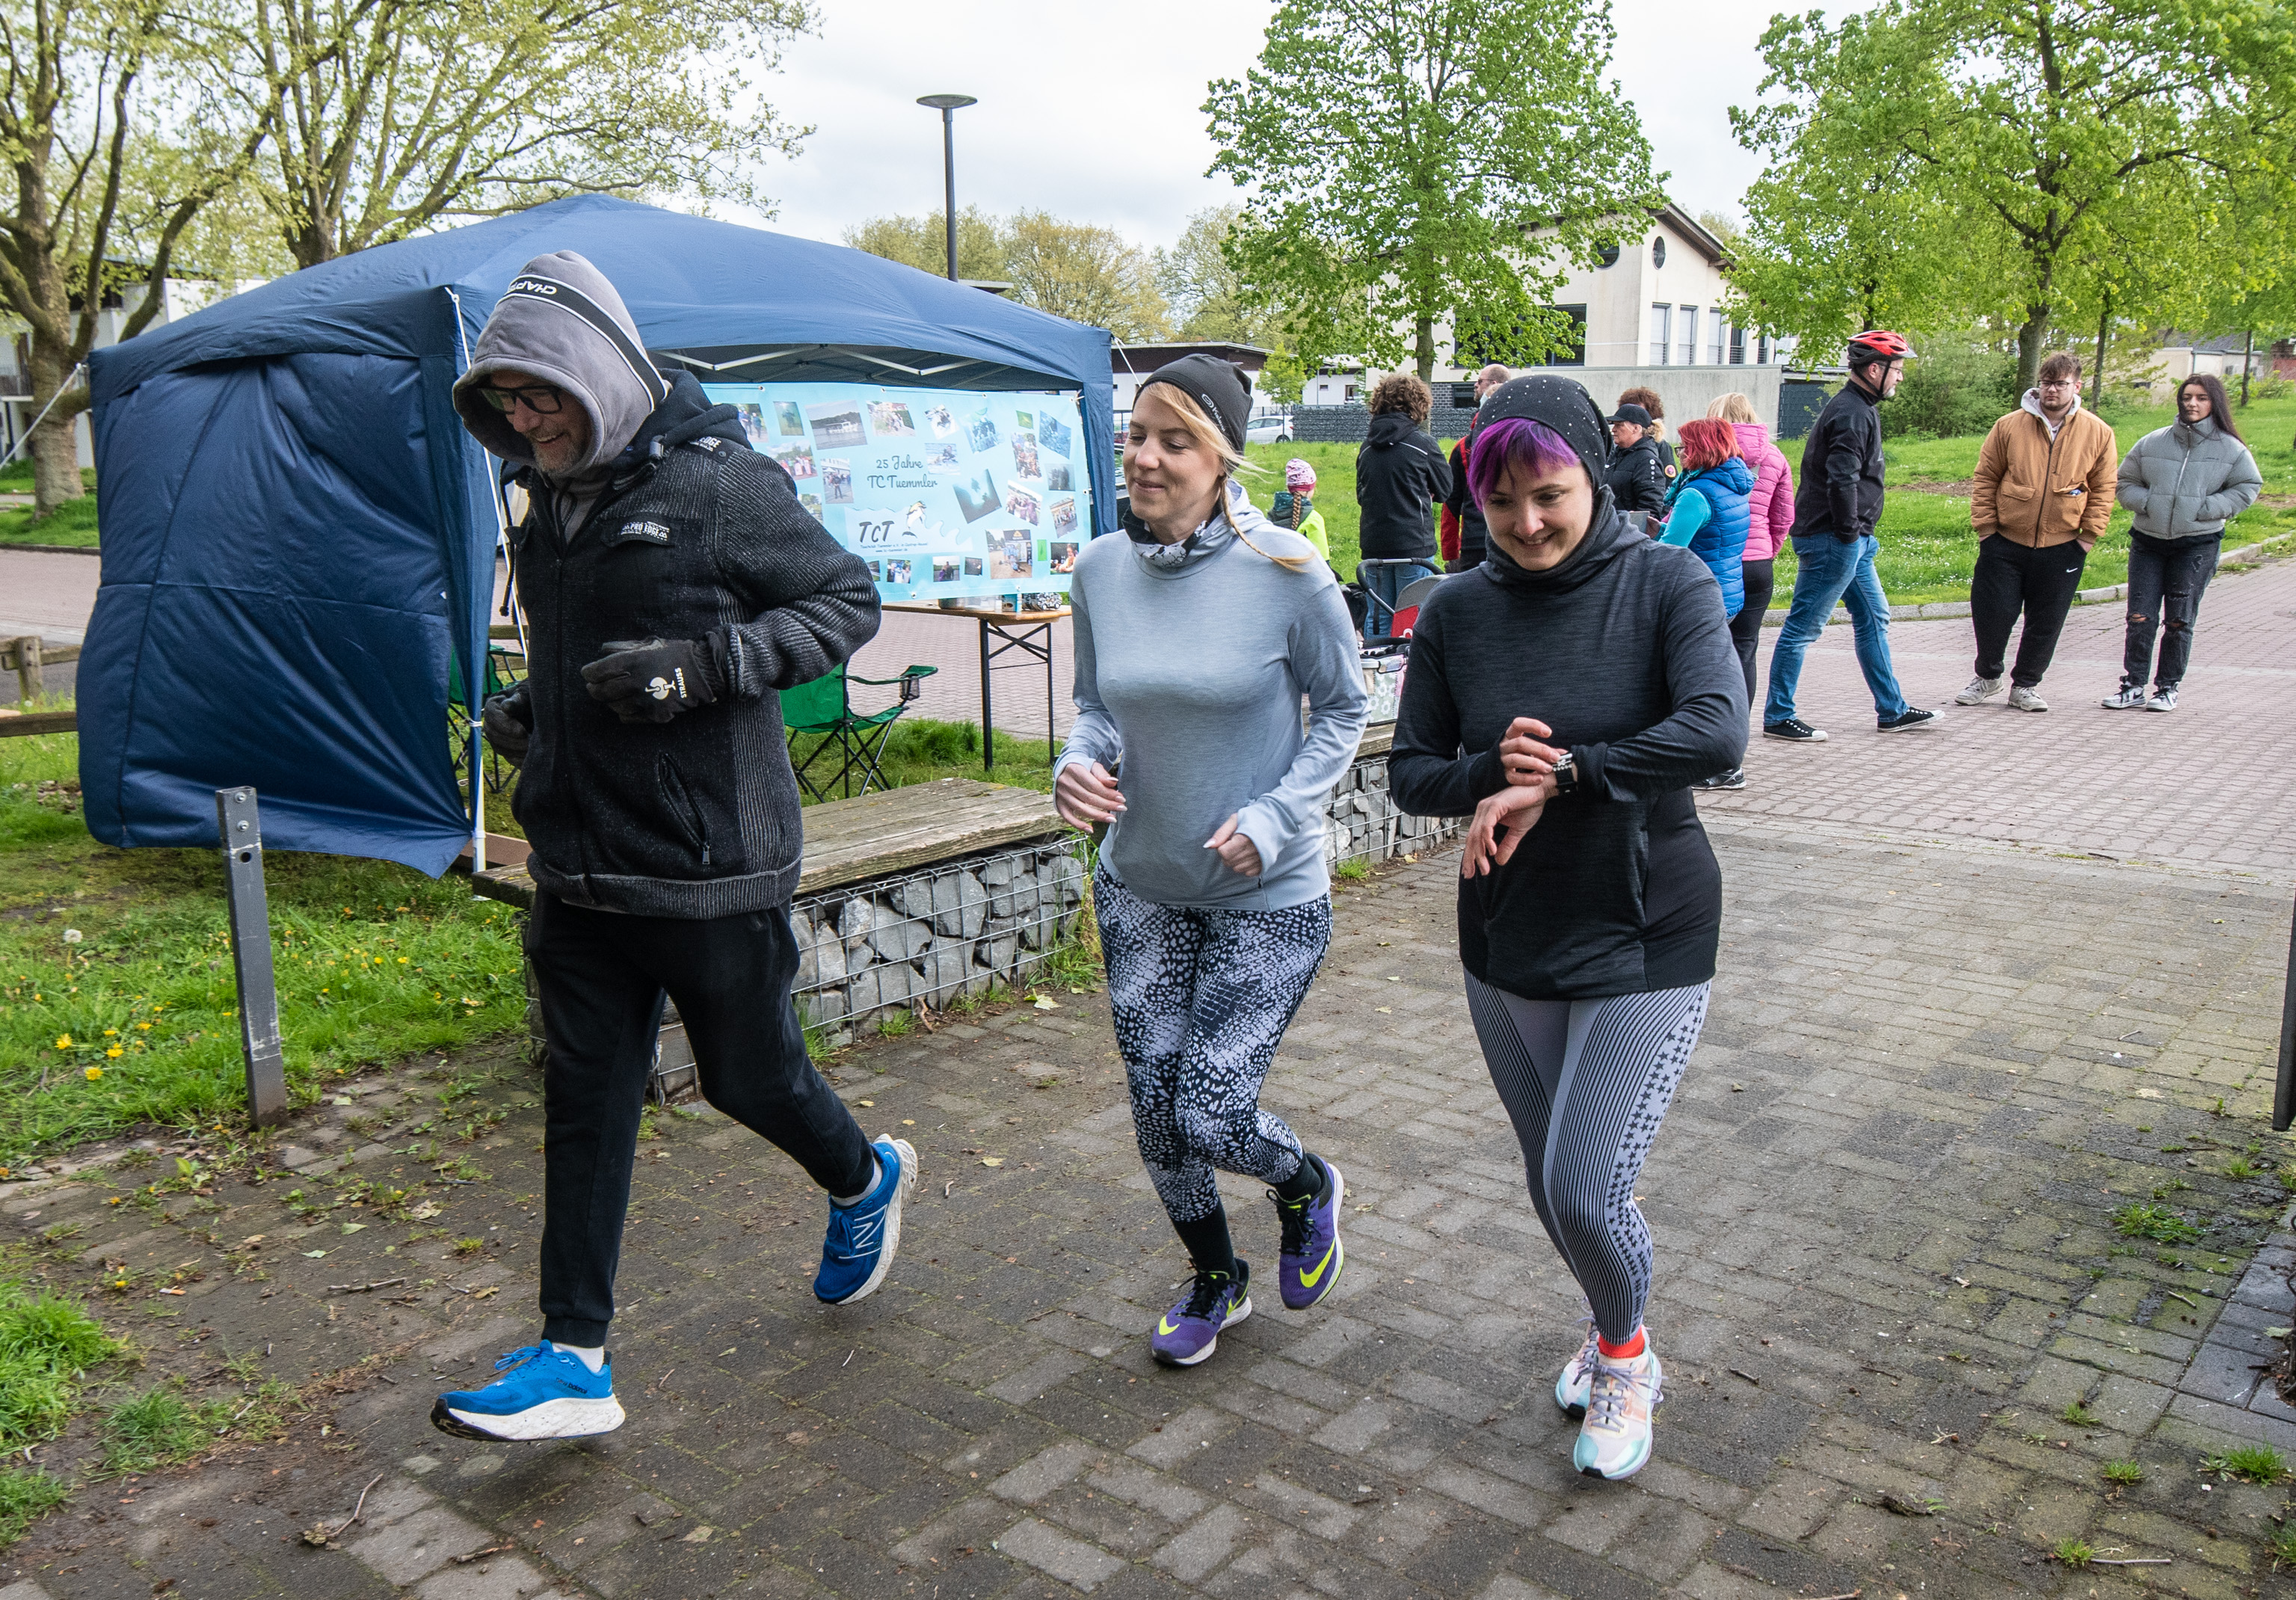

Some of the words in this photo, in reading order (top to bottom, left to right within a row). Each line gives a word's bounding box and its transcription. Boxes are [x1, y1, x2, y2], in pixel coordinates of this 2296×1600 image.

[875, 459, 889, 469] 25
[891, 454, 923, 470] Jahre
[867, 475, 886, 488] TC
[887, 473, 938, 488] Tuemmler
[674, 667, 687, 698] STRAUSS
